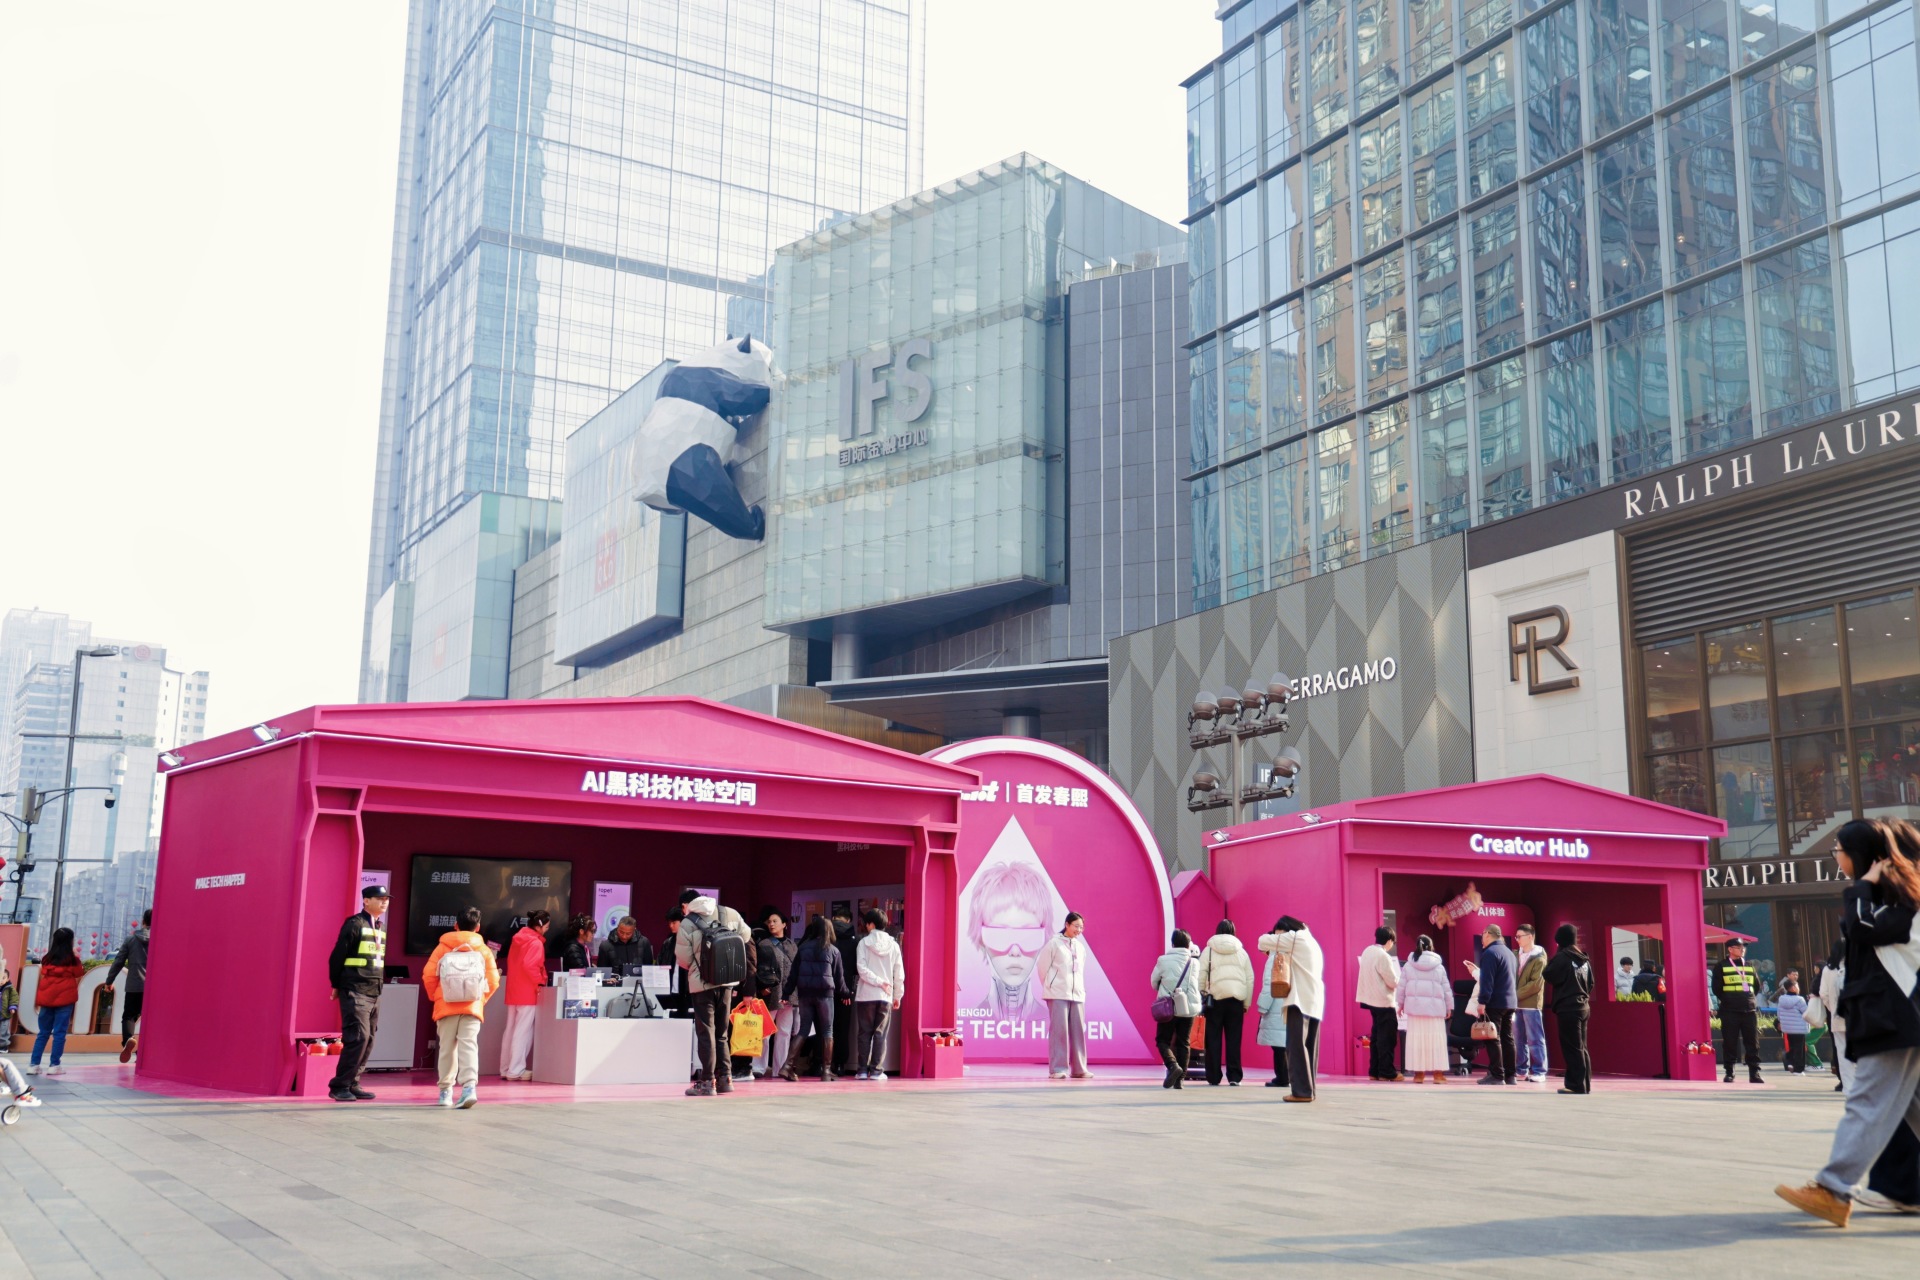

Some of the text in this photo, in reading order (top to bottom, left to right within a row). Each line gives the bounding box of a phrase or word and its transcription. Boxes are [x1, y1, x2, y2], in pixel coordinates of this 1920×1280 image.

[839, 338, 933, 442] IFS
[839, 428, 929, 468] 国际金融中心
[1624, 453, 1754, 520] RALPH
[1290, 656, 1396, 701] ERRAGAMO
[581, 770, 757, 806] AI黑科技体验空间
[1016, 783, 1089, 808] 首发春熙
[1469, 833, 1589, 859] Creator Hub
[430, 871, 471, 884] 全球精选
[511, 875, 550, 888] 科技生活
[1705, 861, 1797, 888] RALPH
[1477, 906, 1506, 917] AI体验
[957, 1008, 993, 1017] HENGDU
[970, 1020, 1026, 1039] TECH
